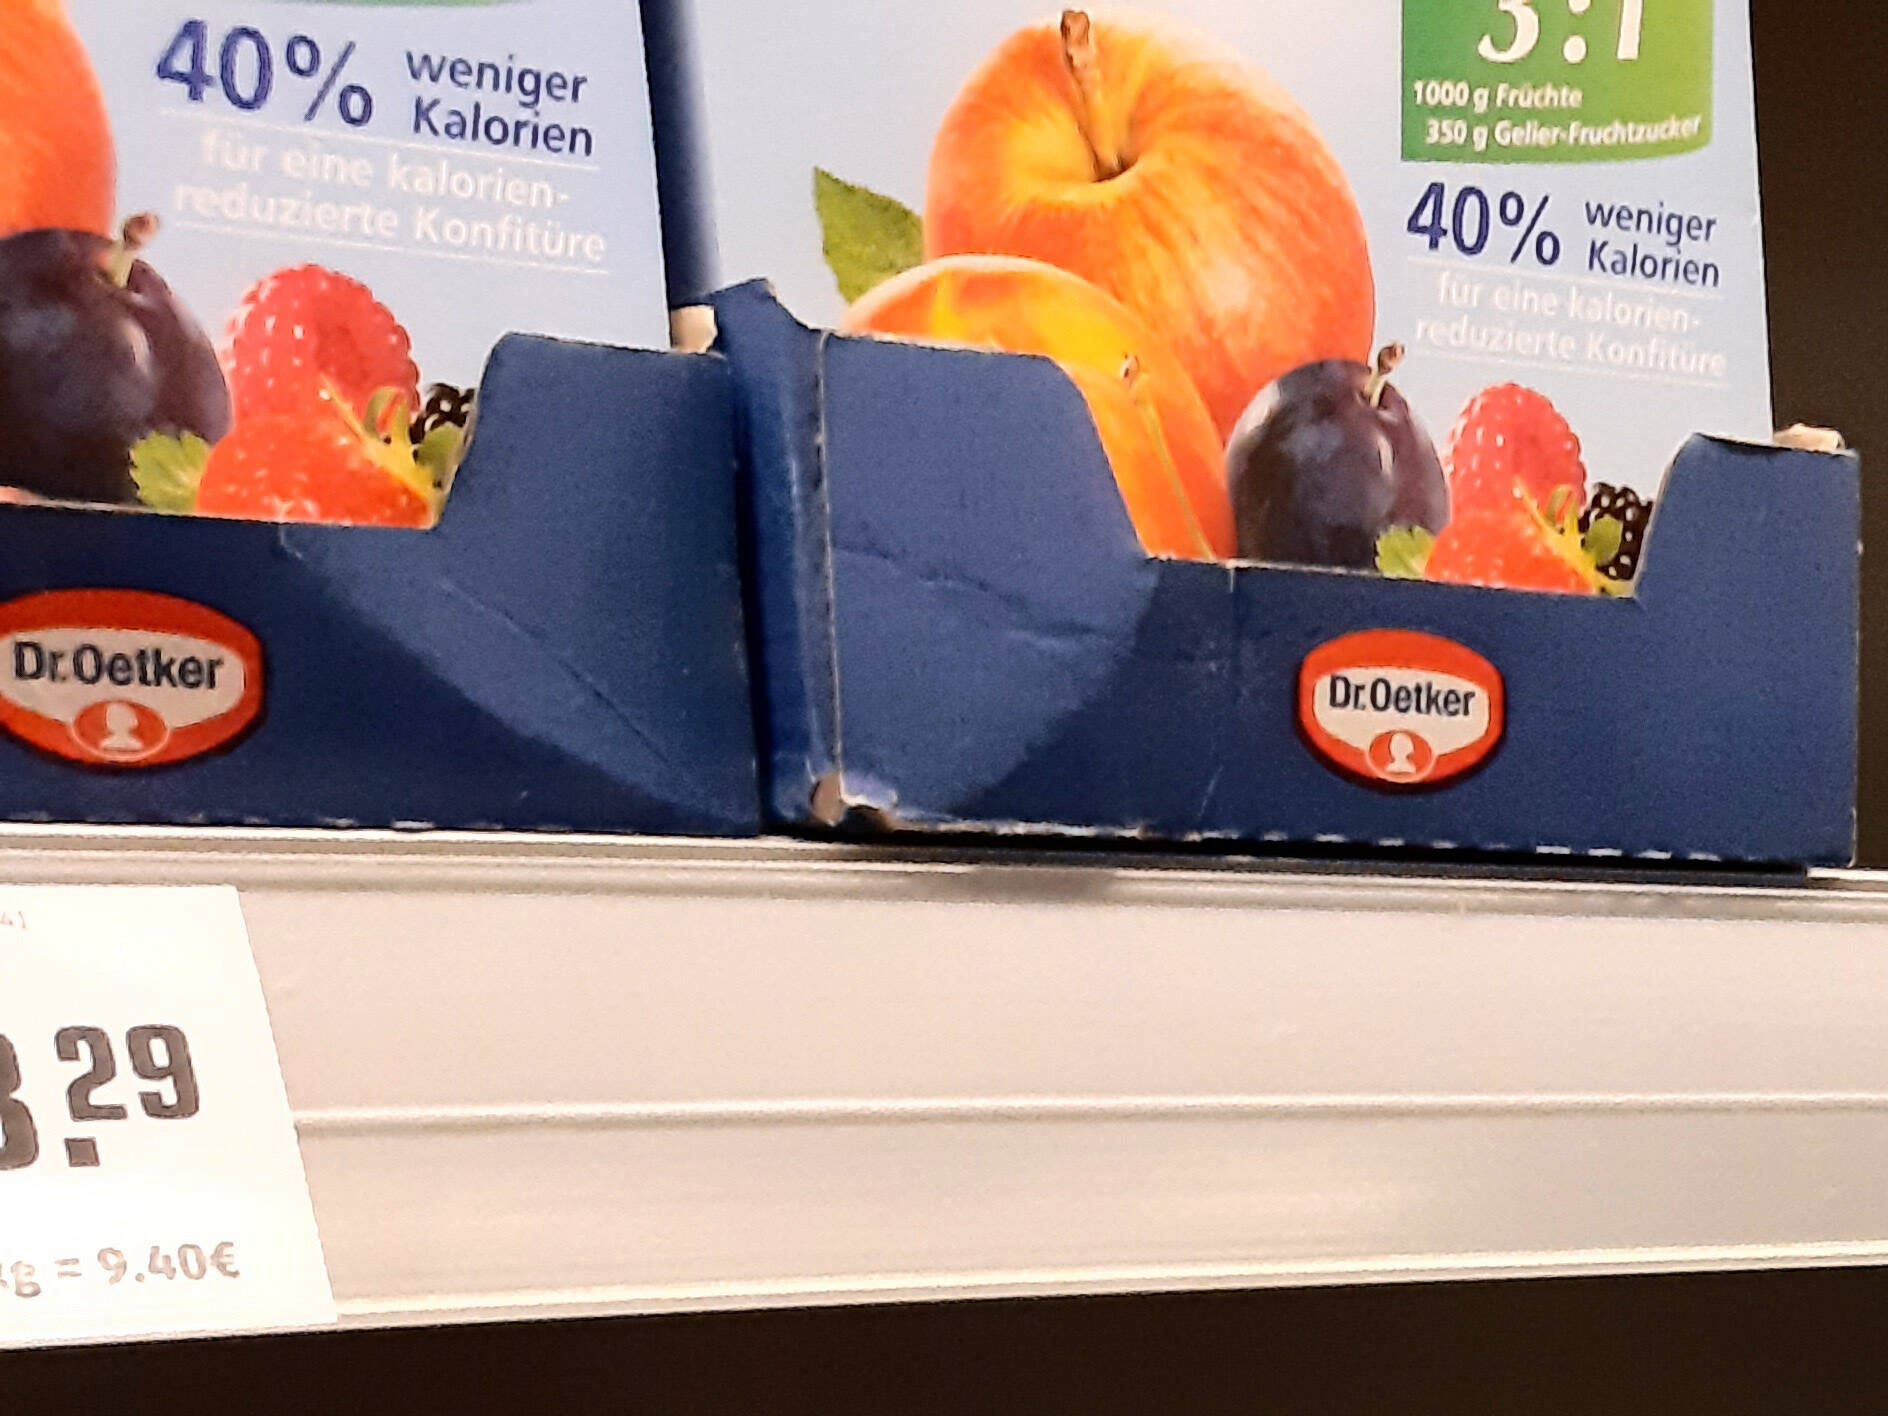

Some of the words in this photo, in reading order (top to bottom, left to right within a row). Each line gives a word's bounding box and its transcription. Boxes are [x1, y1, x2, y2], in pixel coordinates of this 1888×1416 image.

[156, 19, 373, 127] 40%
[406, 49, 587, 115] weniger
[1414, 80, 1469, 107] 1000
[1473, 88, 1490, 113] g
[1496, 82, 1583, 109] Früchte
[412, 97, 593, 157] Kalorien
[1426, 118, 1466, 145] 350
[1473, 126, 1489, 151] g
[200, 131, 263, 171] für
[282, 146, 373, 189] eine
[385, 151, 570, 210] kalorien-
[174, 180, 398, 239] reduzierte
[414, 208, 606, 261] Konfitüre
[1407, 182, 1561, 266] 40%
[1585, 200, 1717, 247] weniger
[1588, 239, 1720, 287] Kalorien
[1495, 281, 1558, 316] eine
[1568, 285, 1702, 333] kalorien-
[1416, 315, 1576, 360] reduzierte
[1586, 332, 1728, 377] Konfitüre
[97, 1240, 240, 1286] 9.40€
